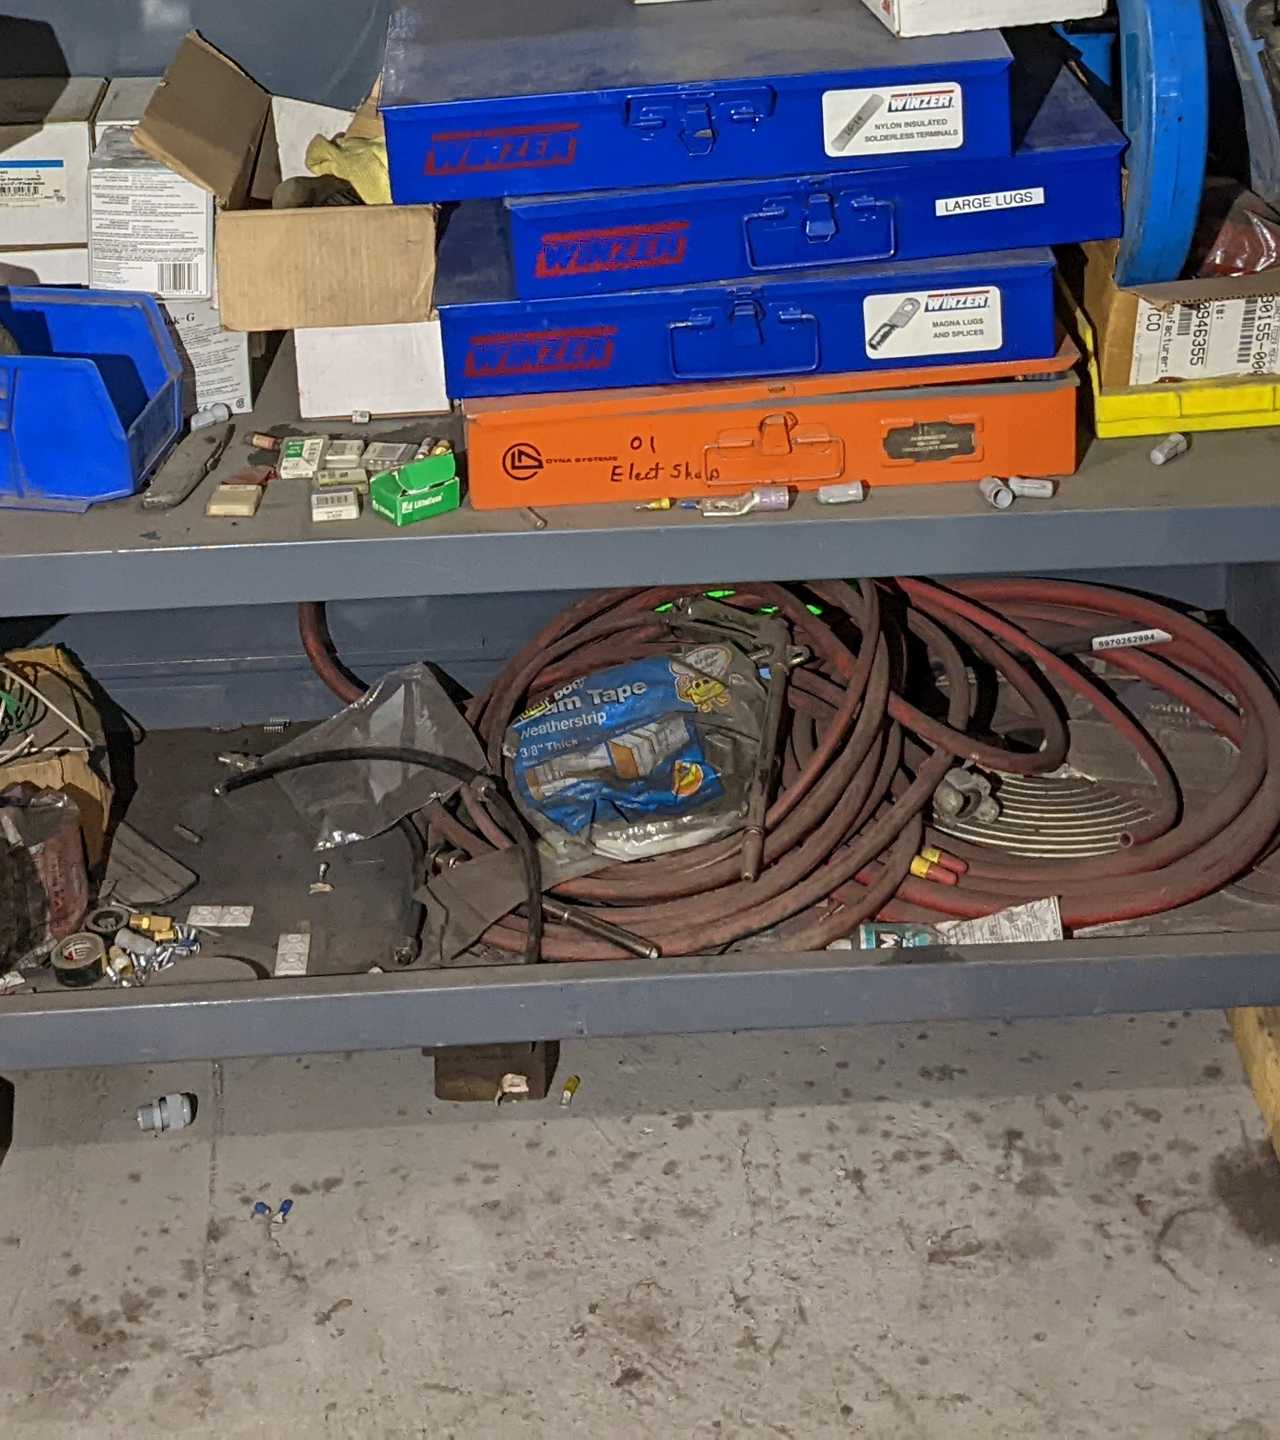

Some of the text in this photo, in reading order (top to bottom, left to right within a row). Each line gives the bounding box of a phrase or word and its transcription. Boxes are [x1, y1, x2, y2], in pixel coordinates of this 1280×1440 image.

[888, 94, 953, 112] WINZER
[874, 118, 948, 130] NYLON INSULATED
[864, 129, 959, 143] SOLDERLESS TERMINALS
[944, 191, 1034, 213] LARGE LUGS
[924, 295, 989, 312] WINZER
[932, 317, 984, 328] MAGNA LUGS
[933, 329, 985, 339] AND SPLICES
[610, 462, 665, 482] Elect
[587, 680, 648, 706] Tape
[545, 738, 579, 755] Thick
